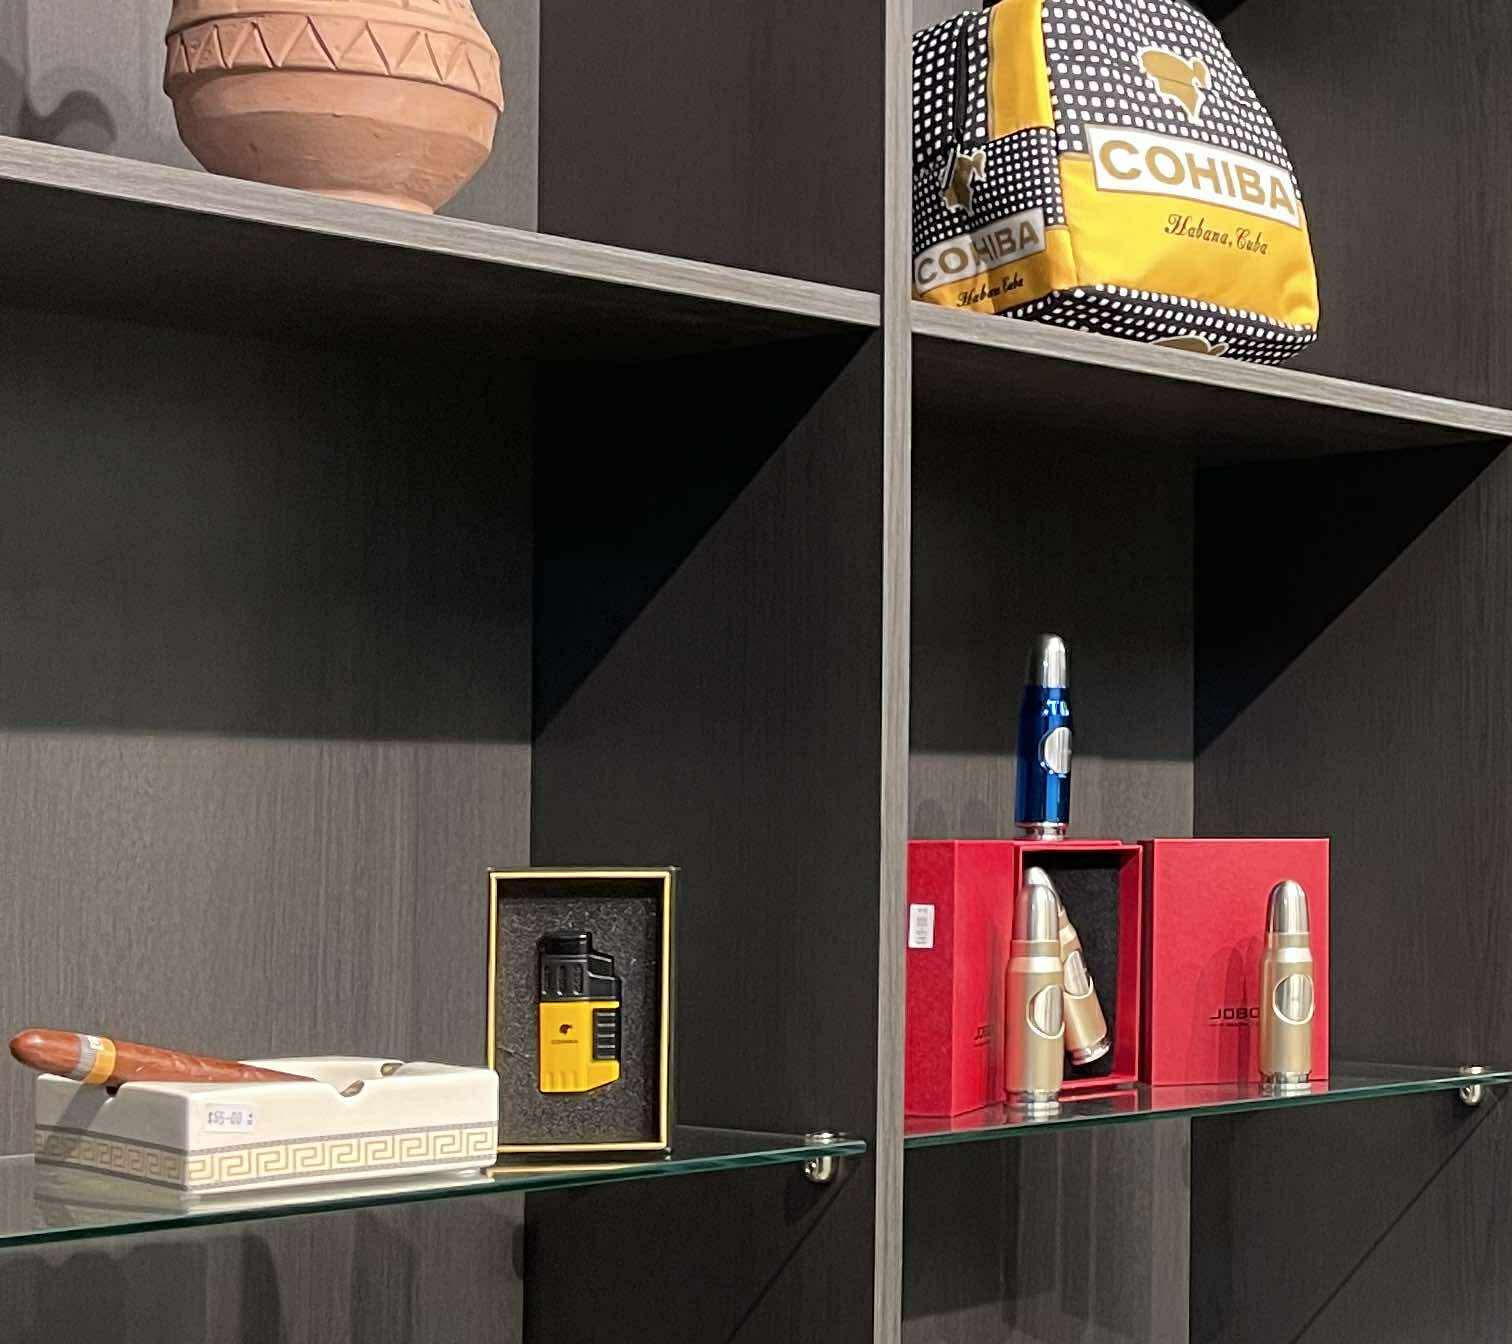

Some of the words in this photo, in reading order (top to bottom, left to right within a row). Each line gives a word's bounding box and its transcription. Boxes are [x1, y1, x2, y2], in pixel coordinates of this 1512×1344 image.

[1099, 139, 1296, 215] COHIBA
[917, 220, 1040, 285] COHIBA
[1164, 213, 1233, 248] Habana,
[1235, 227, 1269, 255] Cuba
